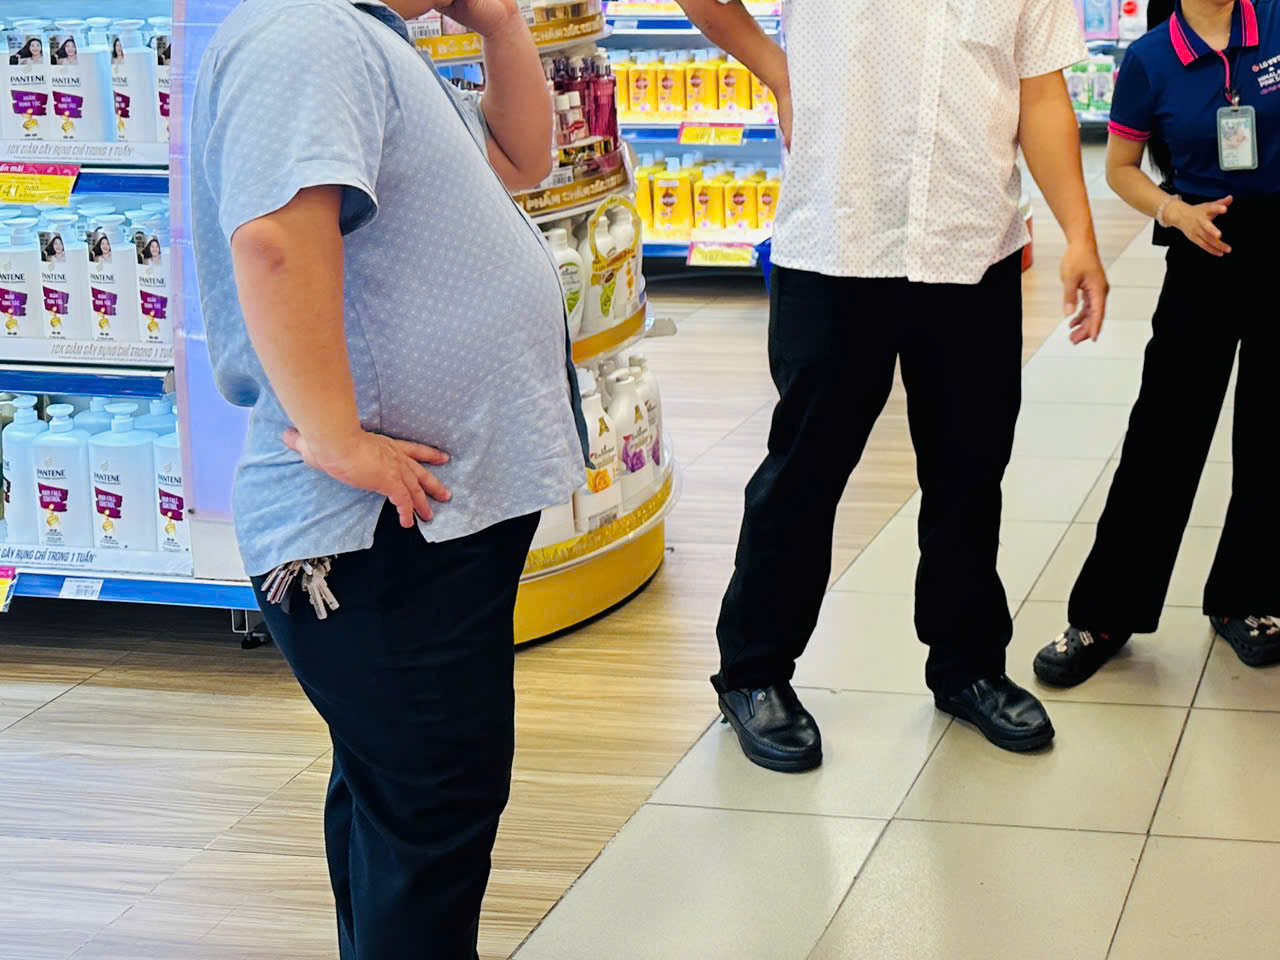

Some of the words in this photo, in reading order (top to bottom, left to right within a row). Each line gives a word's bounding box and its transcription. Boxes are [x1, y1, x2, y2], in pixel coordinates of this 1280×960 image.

[10, 75, 46, 83] PANTENE
[52, 77, 81, 85] PANTENE
[42, 273, 66, 281] PANTENE
[139, 276, 165, 285] PANTENE
[37, 469, 65, 477] PANTENE
[94, 472, 120, 482] PANTENE
[158, 474, 182, 484] PANTENE
